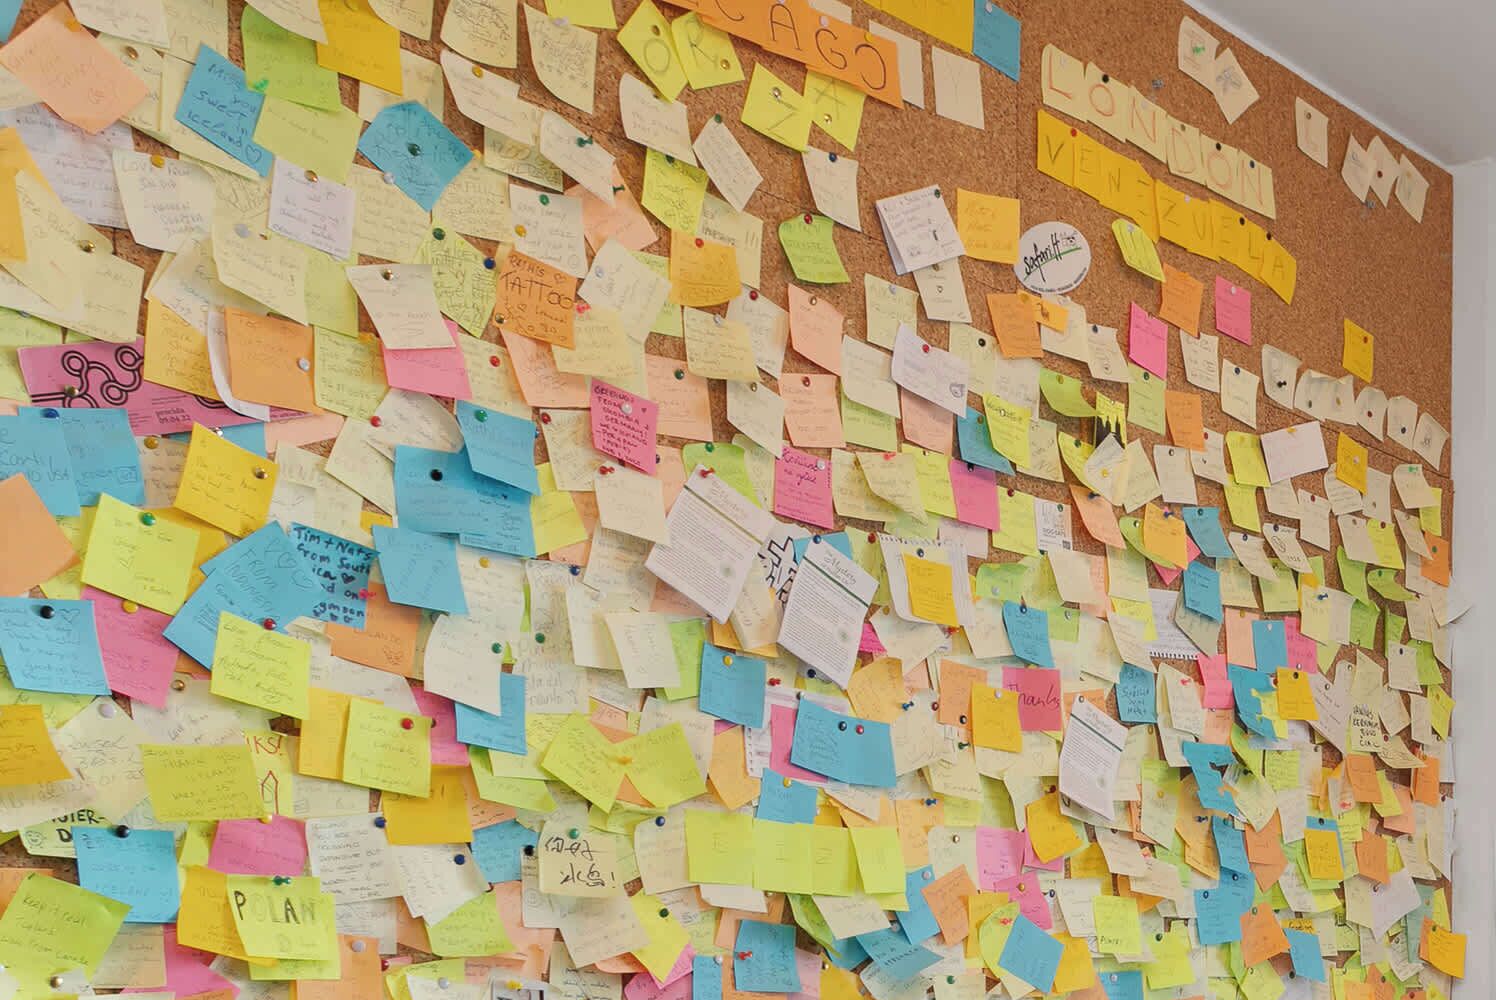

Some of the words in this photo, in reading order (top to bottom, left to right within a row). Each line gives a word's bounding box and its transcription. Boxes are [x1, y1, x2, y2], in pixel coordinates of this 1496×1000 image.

[1049, 50, 1264, 206] LONDON
[501, 269, 574, 311] TATTOO
[293, 526, 321, 545] Tim
[324, 538, 334, 549] +
